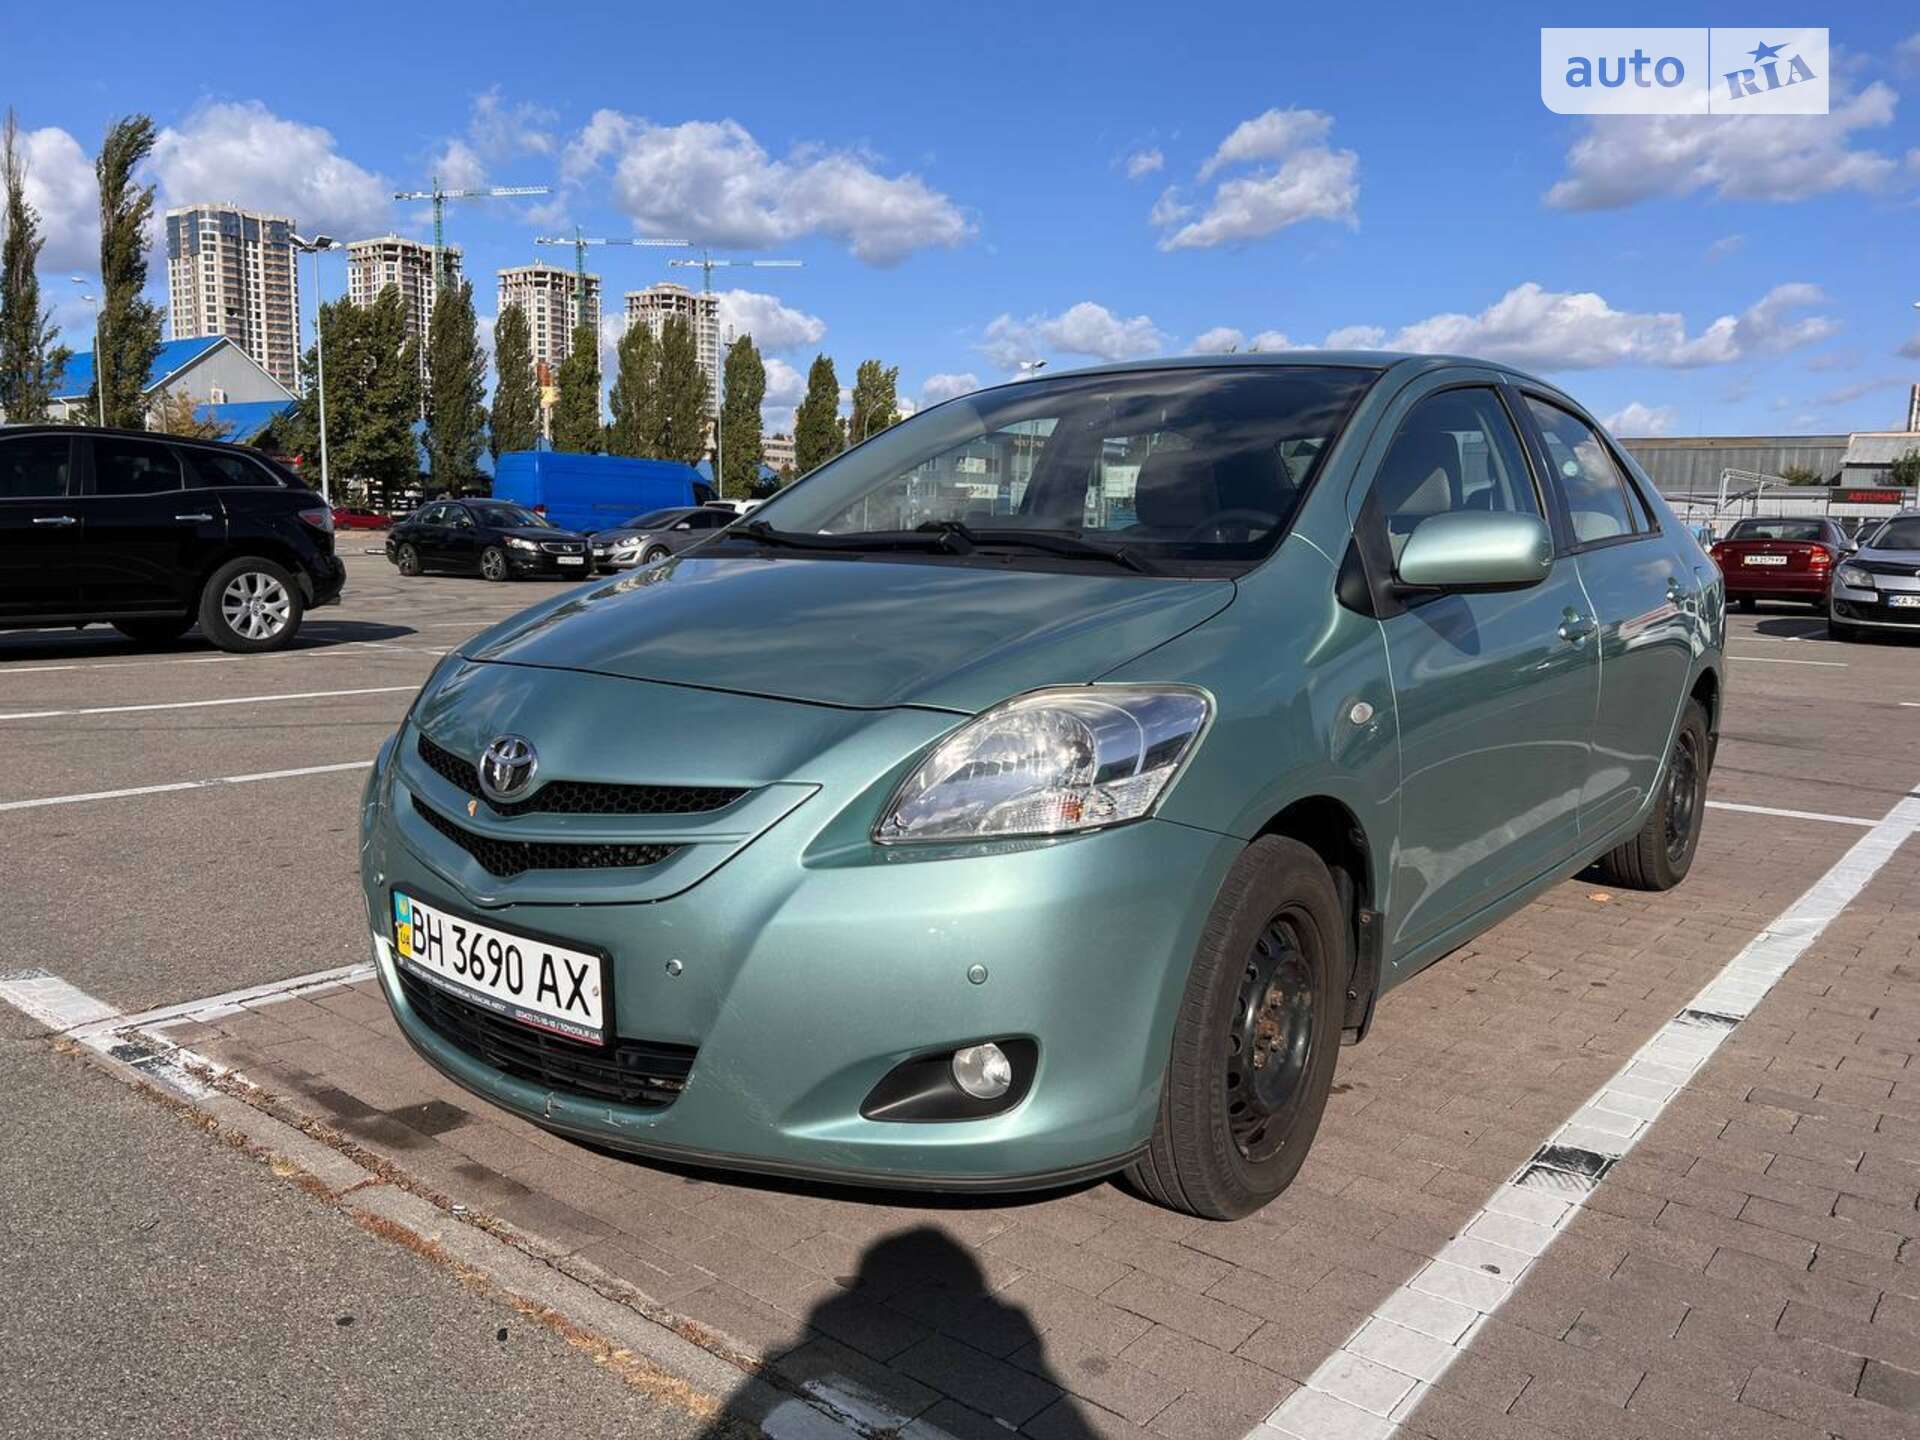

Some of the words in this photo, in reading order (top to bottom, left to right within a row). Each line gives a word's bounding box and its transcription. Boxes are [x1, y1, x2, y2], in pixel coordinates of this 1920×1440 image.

[411, 906, 444, 967] BH
[452, 925, 523, 995] 3690
[536, 953, 591, 1017] AX
